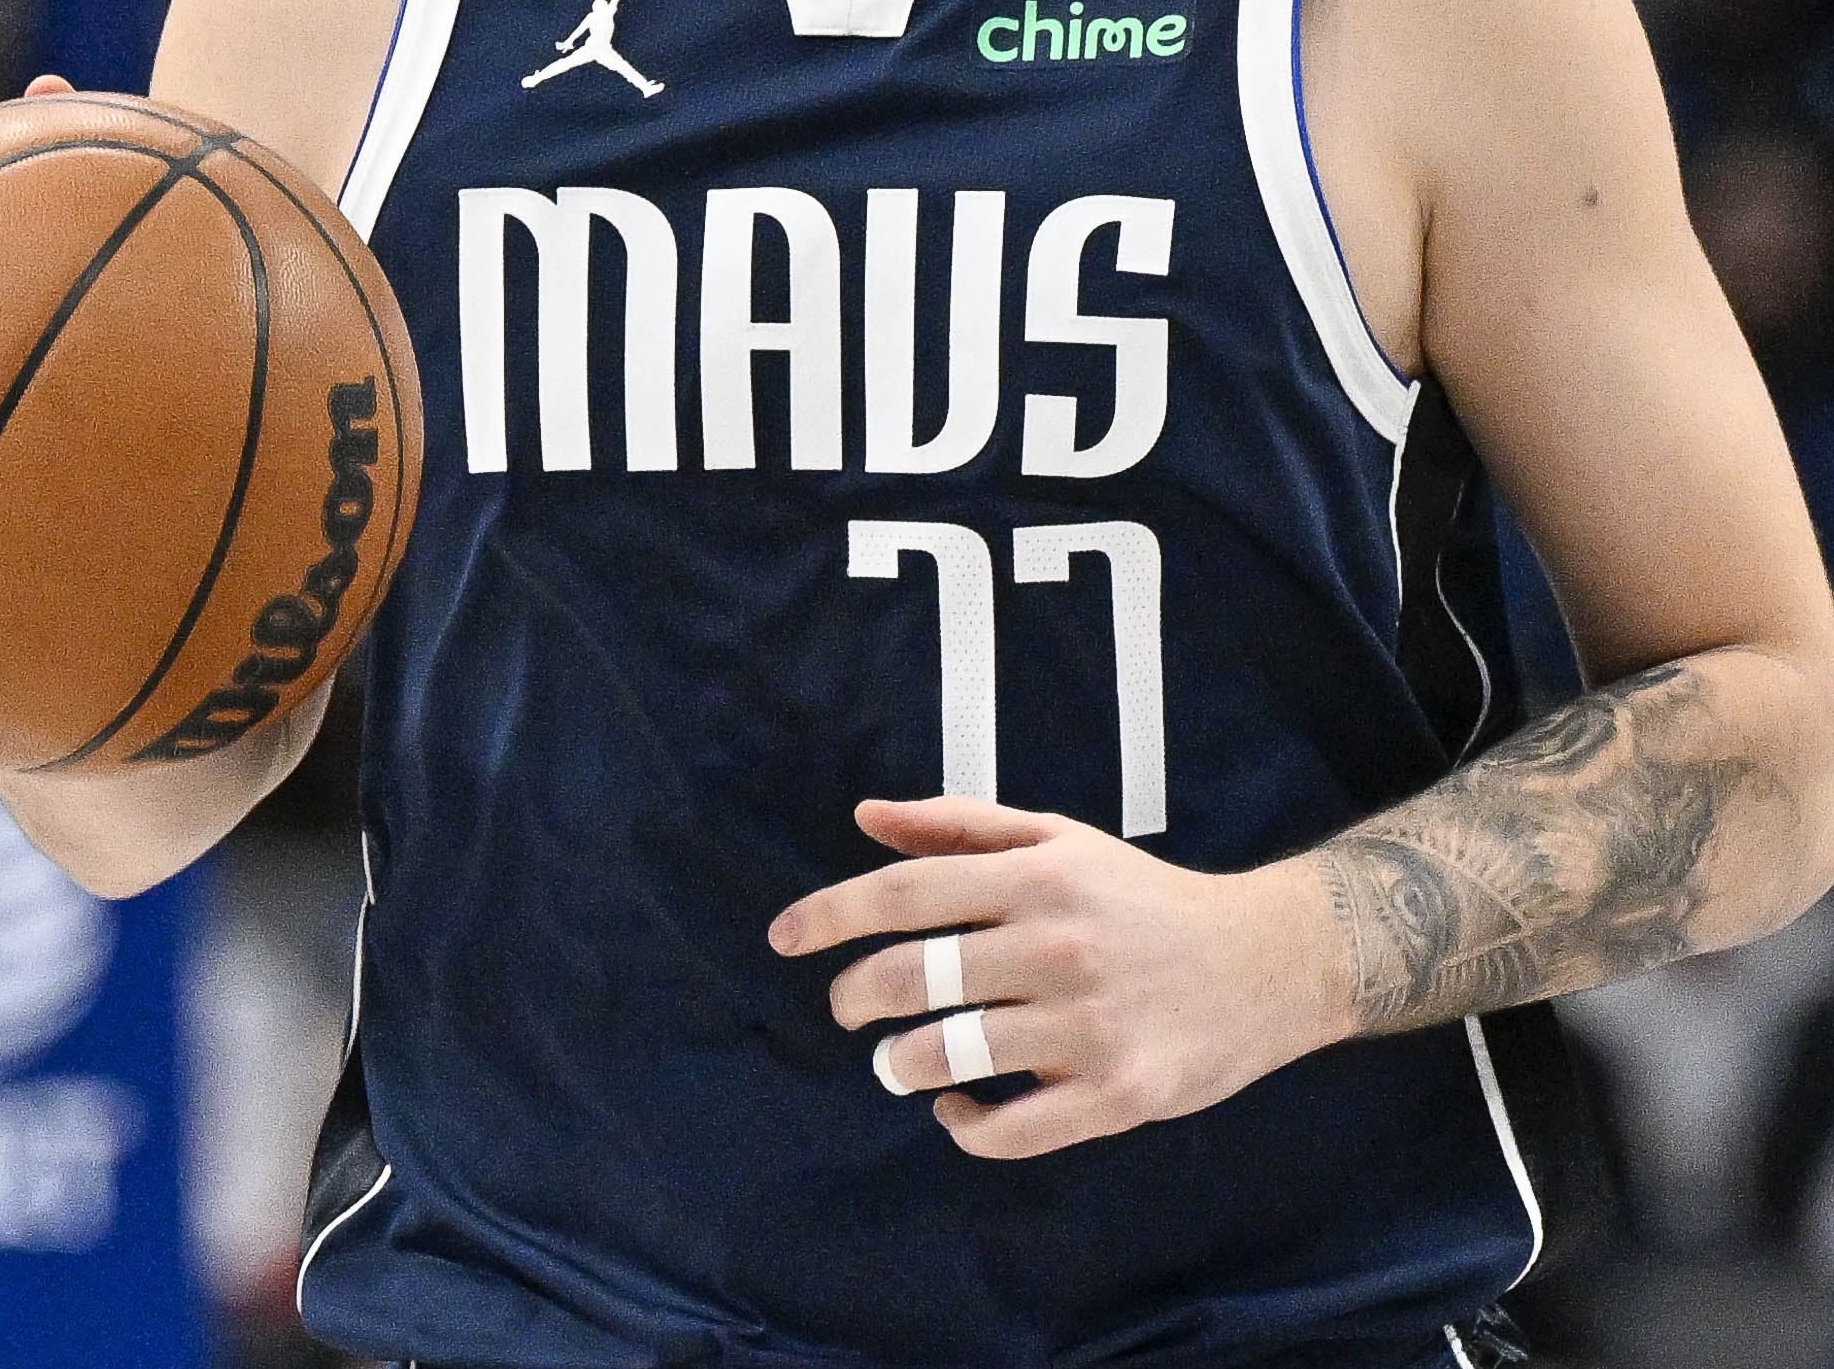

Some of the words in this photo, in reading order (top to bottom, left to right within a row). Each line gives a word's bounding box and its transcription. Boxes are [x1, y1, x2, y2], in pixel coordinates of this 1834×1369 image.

[976, 0, 1187, 64] chime
[458, 186, 1176, 479] MAVS
[129, 375, 379, 761] Wilson
[848, 519, 1166, 838] 77
